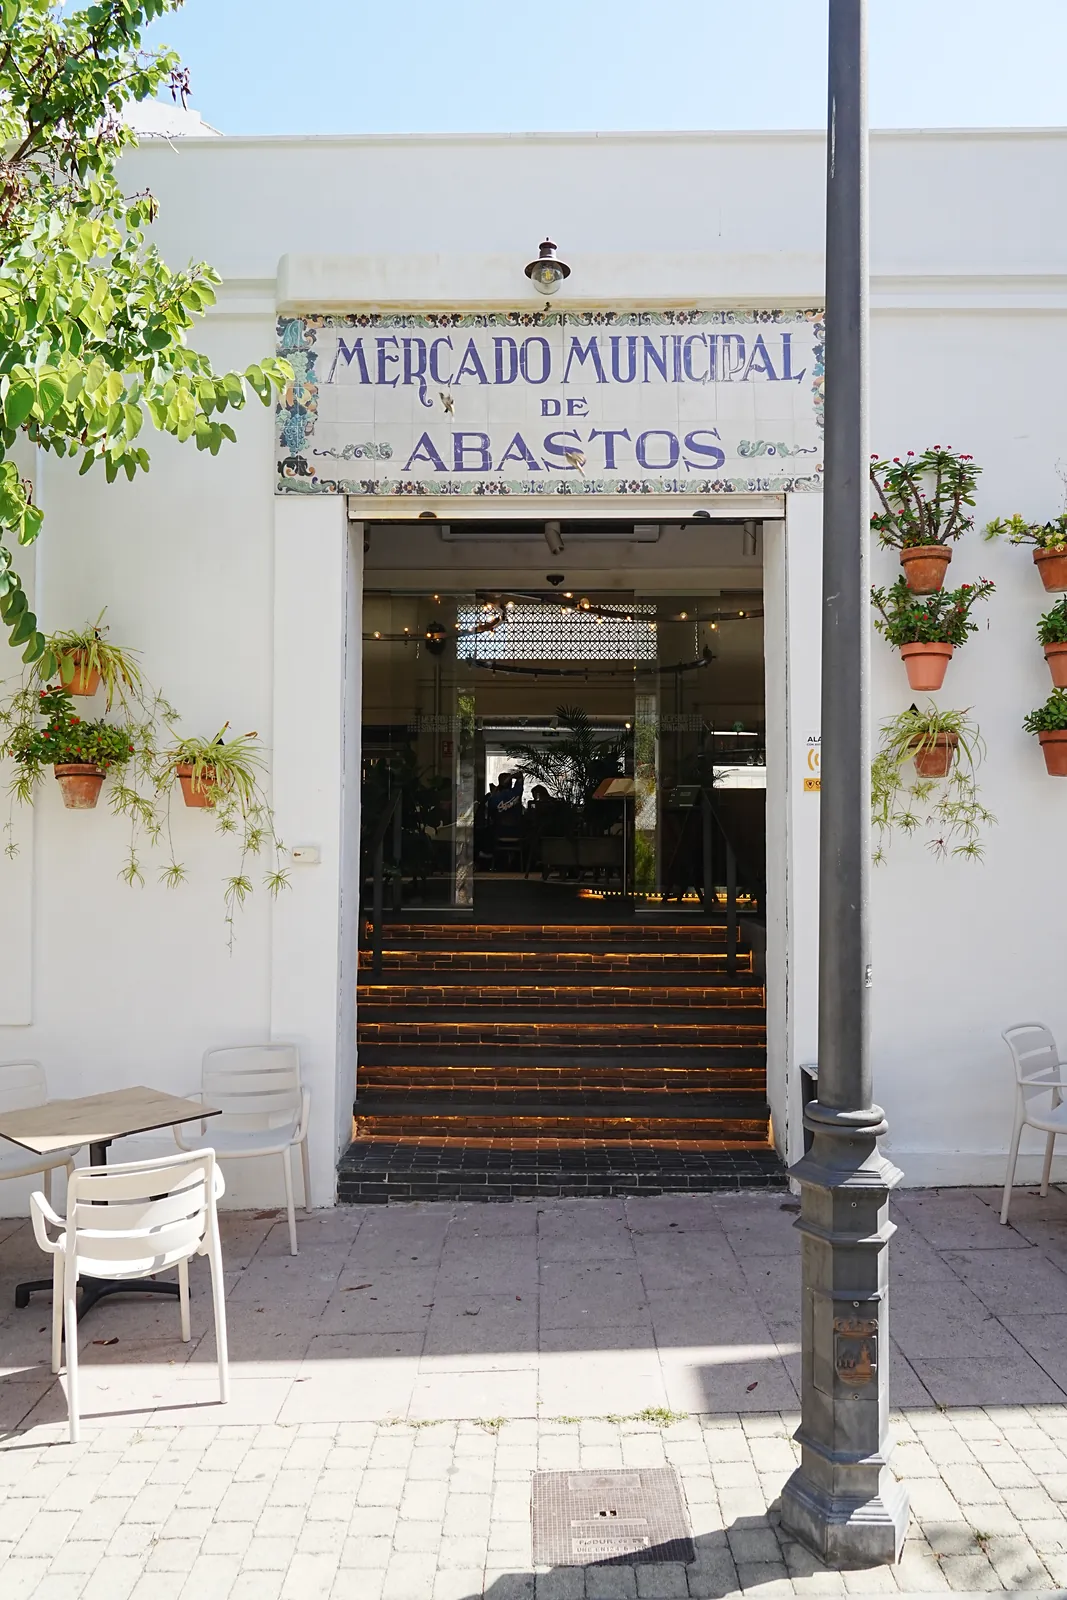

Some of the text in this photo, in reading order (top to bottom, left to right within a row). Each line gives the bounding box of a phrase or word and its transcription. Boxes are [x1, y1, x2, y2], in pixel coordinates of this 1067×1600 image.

[326, 332, 806, 407] MERCADO MUNICIPAL
[540, 398, 590, 418] DE
[401, 427, 727, 472] ABASTOS
